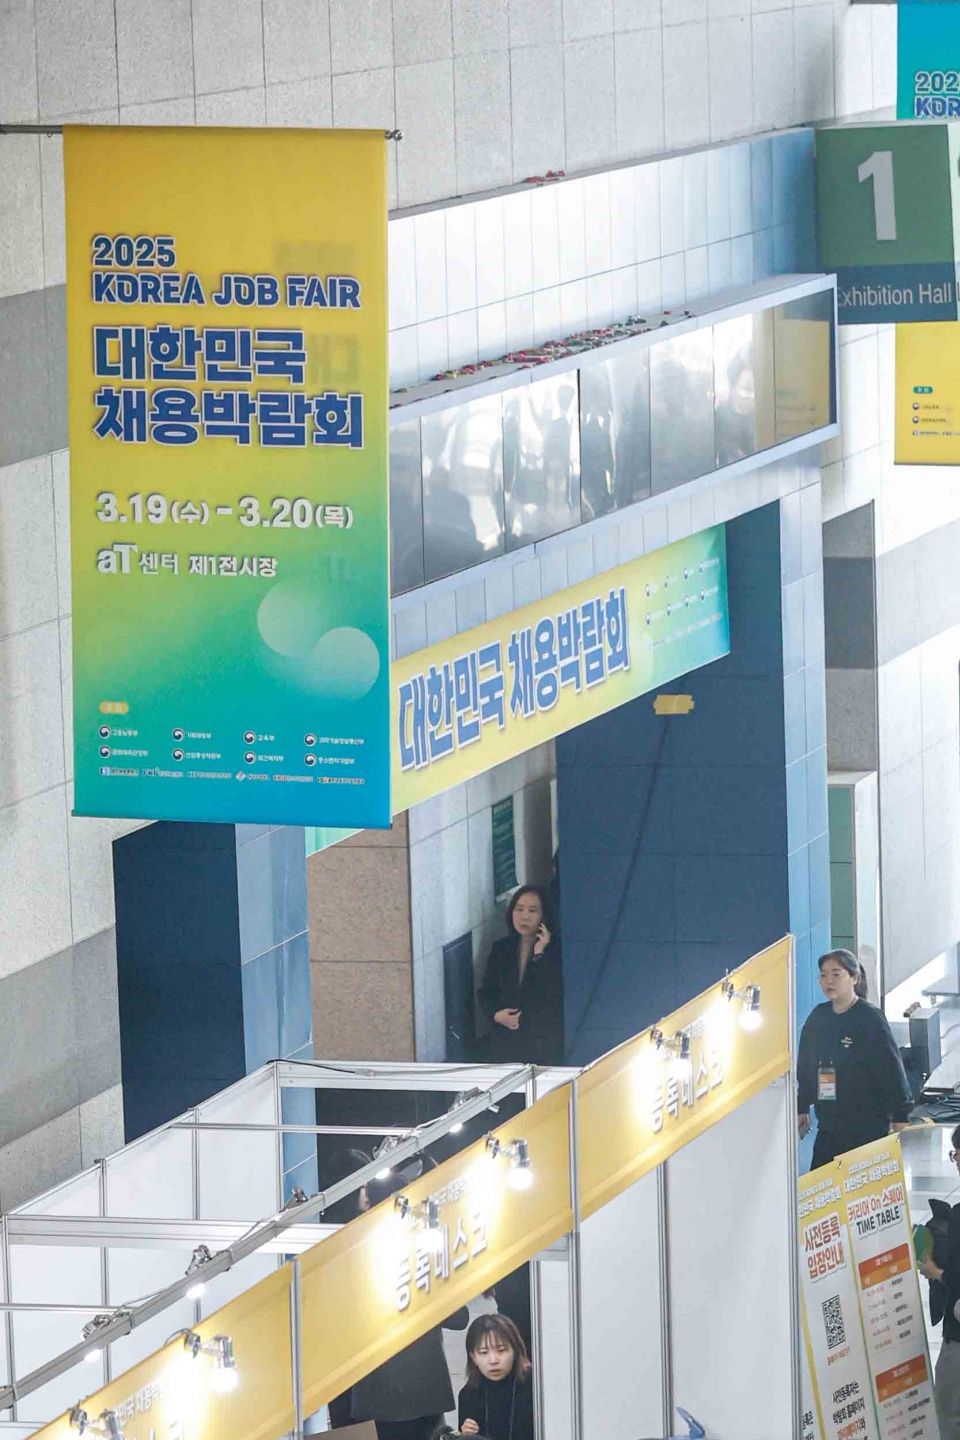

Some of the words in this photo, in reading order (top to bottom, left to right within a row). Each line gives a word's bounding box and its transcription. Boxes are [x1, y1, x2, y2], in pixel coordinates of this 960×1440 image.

[857, 151, 897, 241] 1
[93, 236, 175, 267] 2025
[93, 273, 205, 305] KOREA
[213, 275, 279, 306] JOB
[286, 276, 361, 309] FAIR
[836, 284, 913, 307] Exhibition
[919, 283, 952, 304] Hall
[94, 325, 306, 383] 대한민국
[95, 386, 363, 448] 채용박람회
[189, 554, 278, 577] 제1전시장
[398, 638, 505, 773] 대한민국
[507, 585, 631, 721] 채용박람회
[805, 1215, 841, 1253] 사전등록
[856, 1216, 876, 1235] TIME
[876, 1206, 901, 1227] TABLE
[807, 1241, 845, 1279] 입장안내
